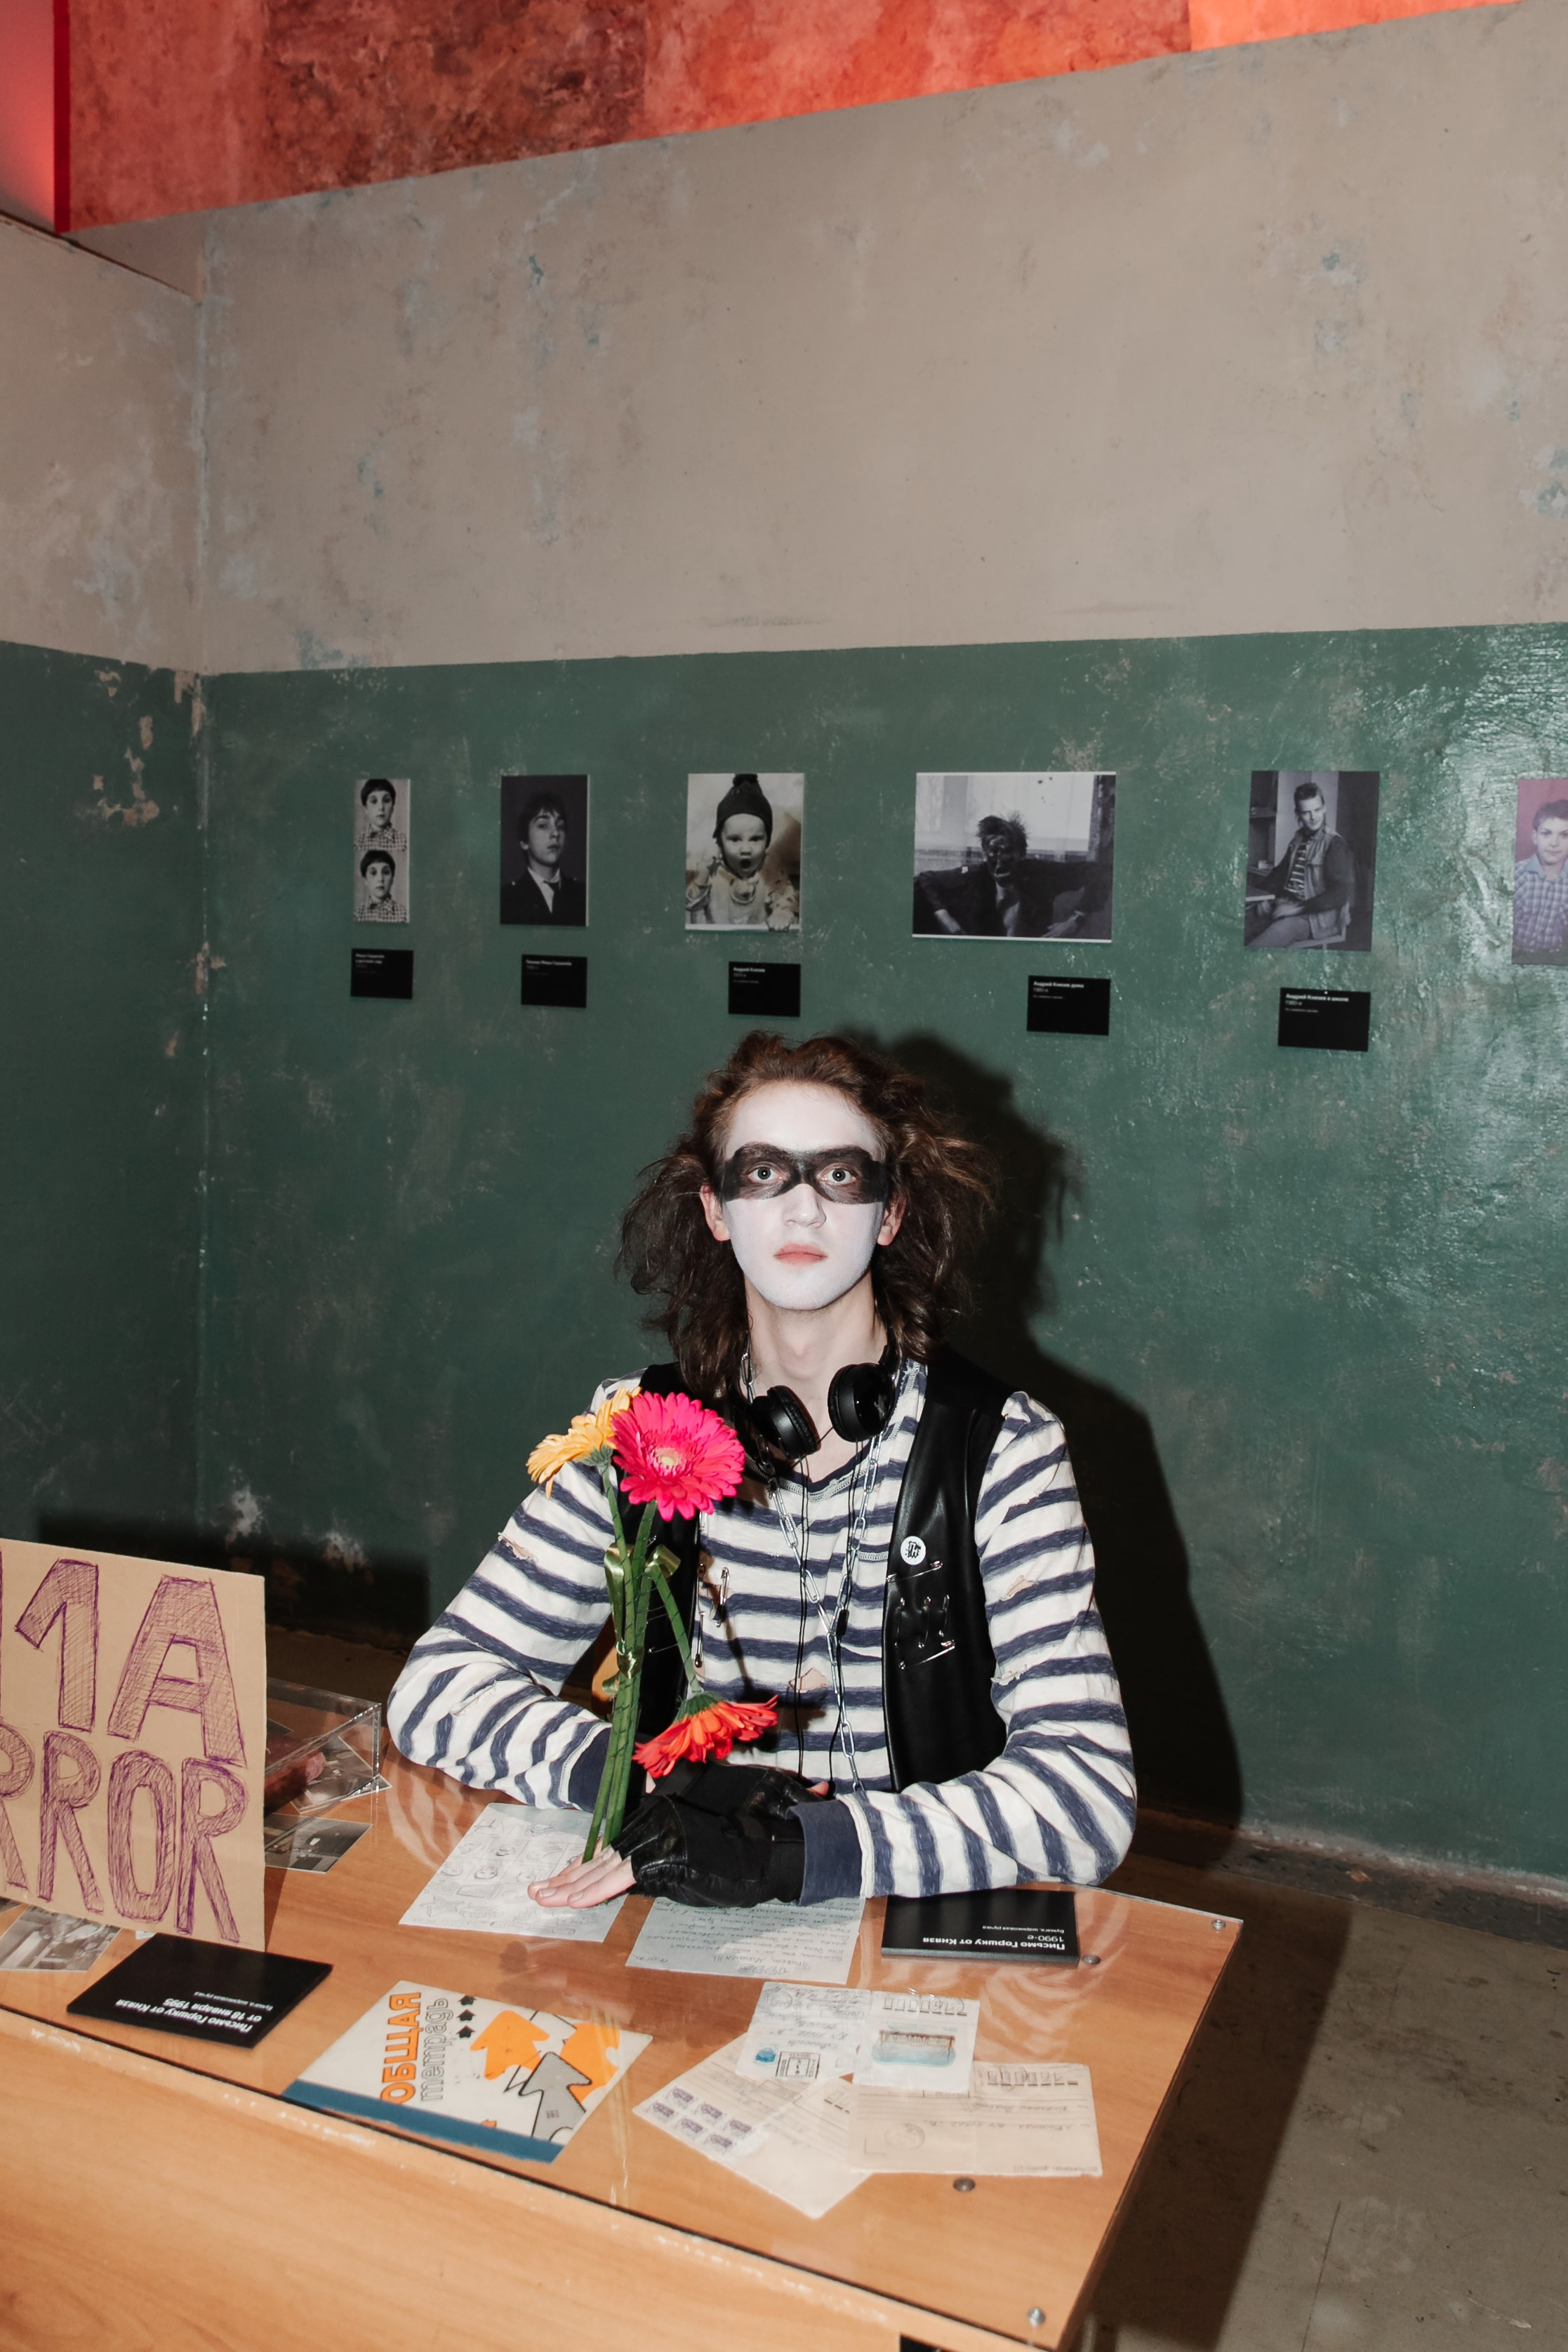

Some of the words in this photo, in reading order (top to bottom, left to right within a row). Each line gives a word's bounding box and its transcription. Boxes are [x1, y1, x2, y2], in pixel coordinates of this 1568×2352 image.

[975, 1939, 1018, 1948] Горшку
[1021, 1941, 1065, 1951] Письмо
[116, 1999, 150, 2012] Князя
[150, 2005, 165, 2014] от
[162, 1998, 190, 2009] 1995
[192, 2003, 232, 2016] января
[164, 2009, 206, 2024] Горшку
[231, 2010, 246, 2021] 18
[246, 2014, 262, 2023] от
[208, 2017, 253, 2033] Письмо
[380, 1992, 423, 2105] ОБЩАЯ
[421, 1998, 454, 2101] тетрадь
